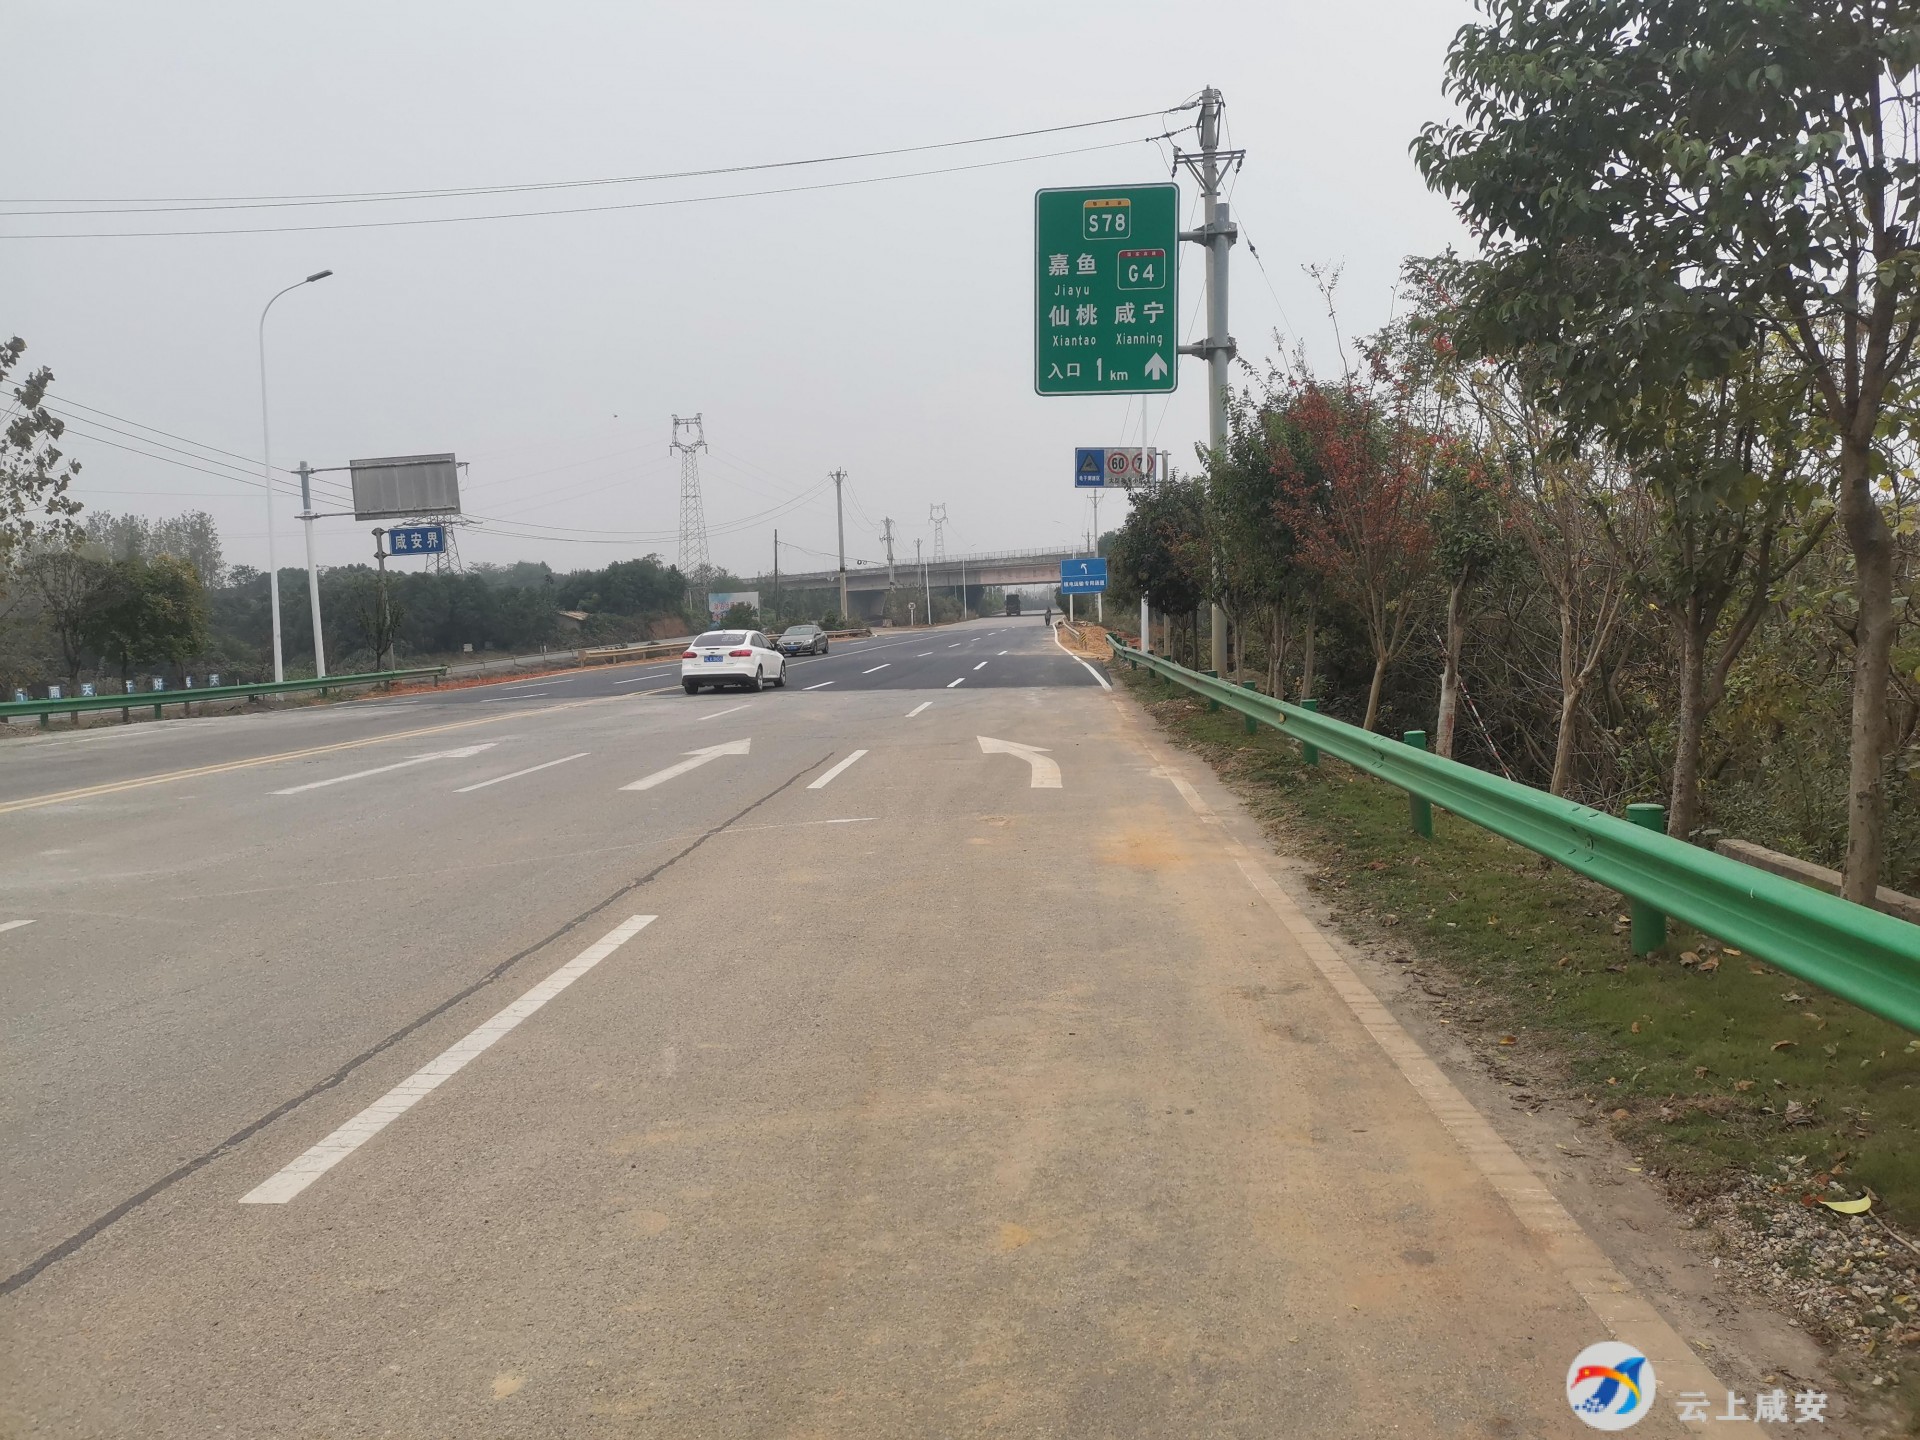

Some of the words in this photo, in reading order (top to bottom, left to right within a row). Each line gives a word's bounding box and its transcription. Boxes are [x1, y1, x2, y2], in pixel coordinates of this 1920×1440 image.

[1088, 213, 1126, 233] S78
[1048, 253, 1097, 276] 嘉鱼
[1128, 263, 1154, 282] G4
[1054, 284, 1090, 298] Jiayu
[1048, 303, 1098, 327] 仙桃
[1114, 301, 1164, 325] 咸宁
[1052, 334, 1097, 347] Xiantao
[1116, 332, 1163, 347] Xianning
[1047, 363, 1080, 379] 入口
[1111, 457, 1125, 470] 60
[395, 531, 438, 550] 咸安界
